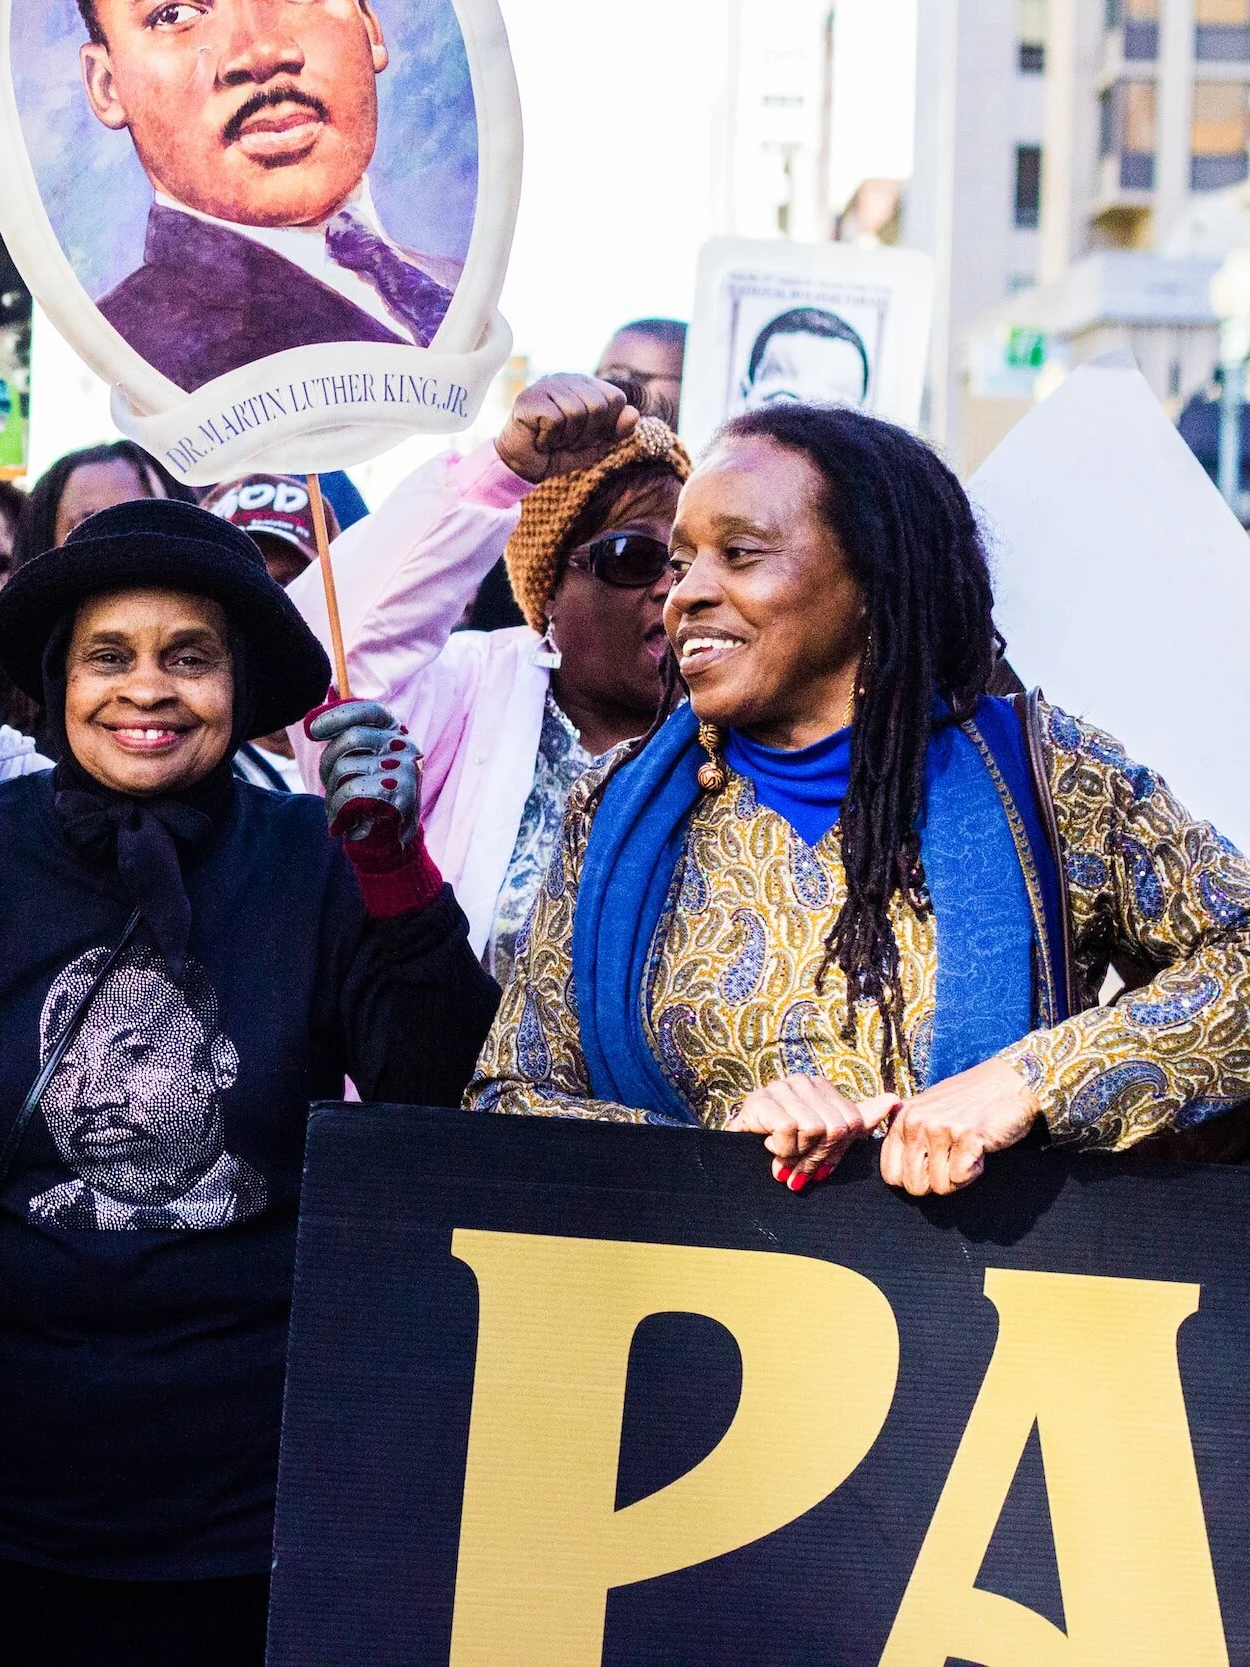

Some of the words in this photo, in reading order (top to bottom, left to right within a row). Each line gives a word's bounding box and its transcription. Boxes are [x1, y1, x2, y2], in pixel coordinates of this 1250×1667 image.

[165, 436, 208, 474] DR.
[198, 388, 288, 452] MARTIN
[289, 373, 376, 412] LUTHER
[450, 1228, 1230, 1667] PA
